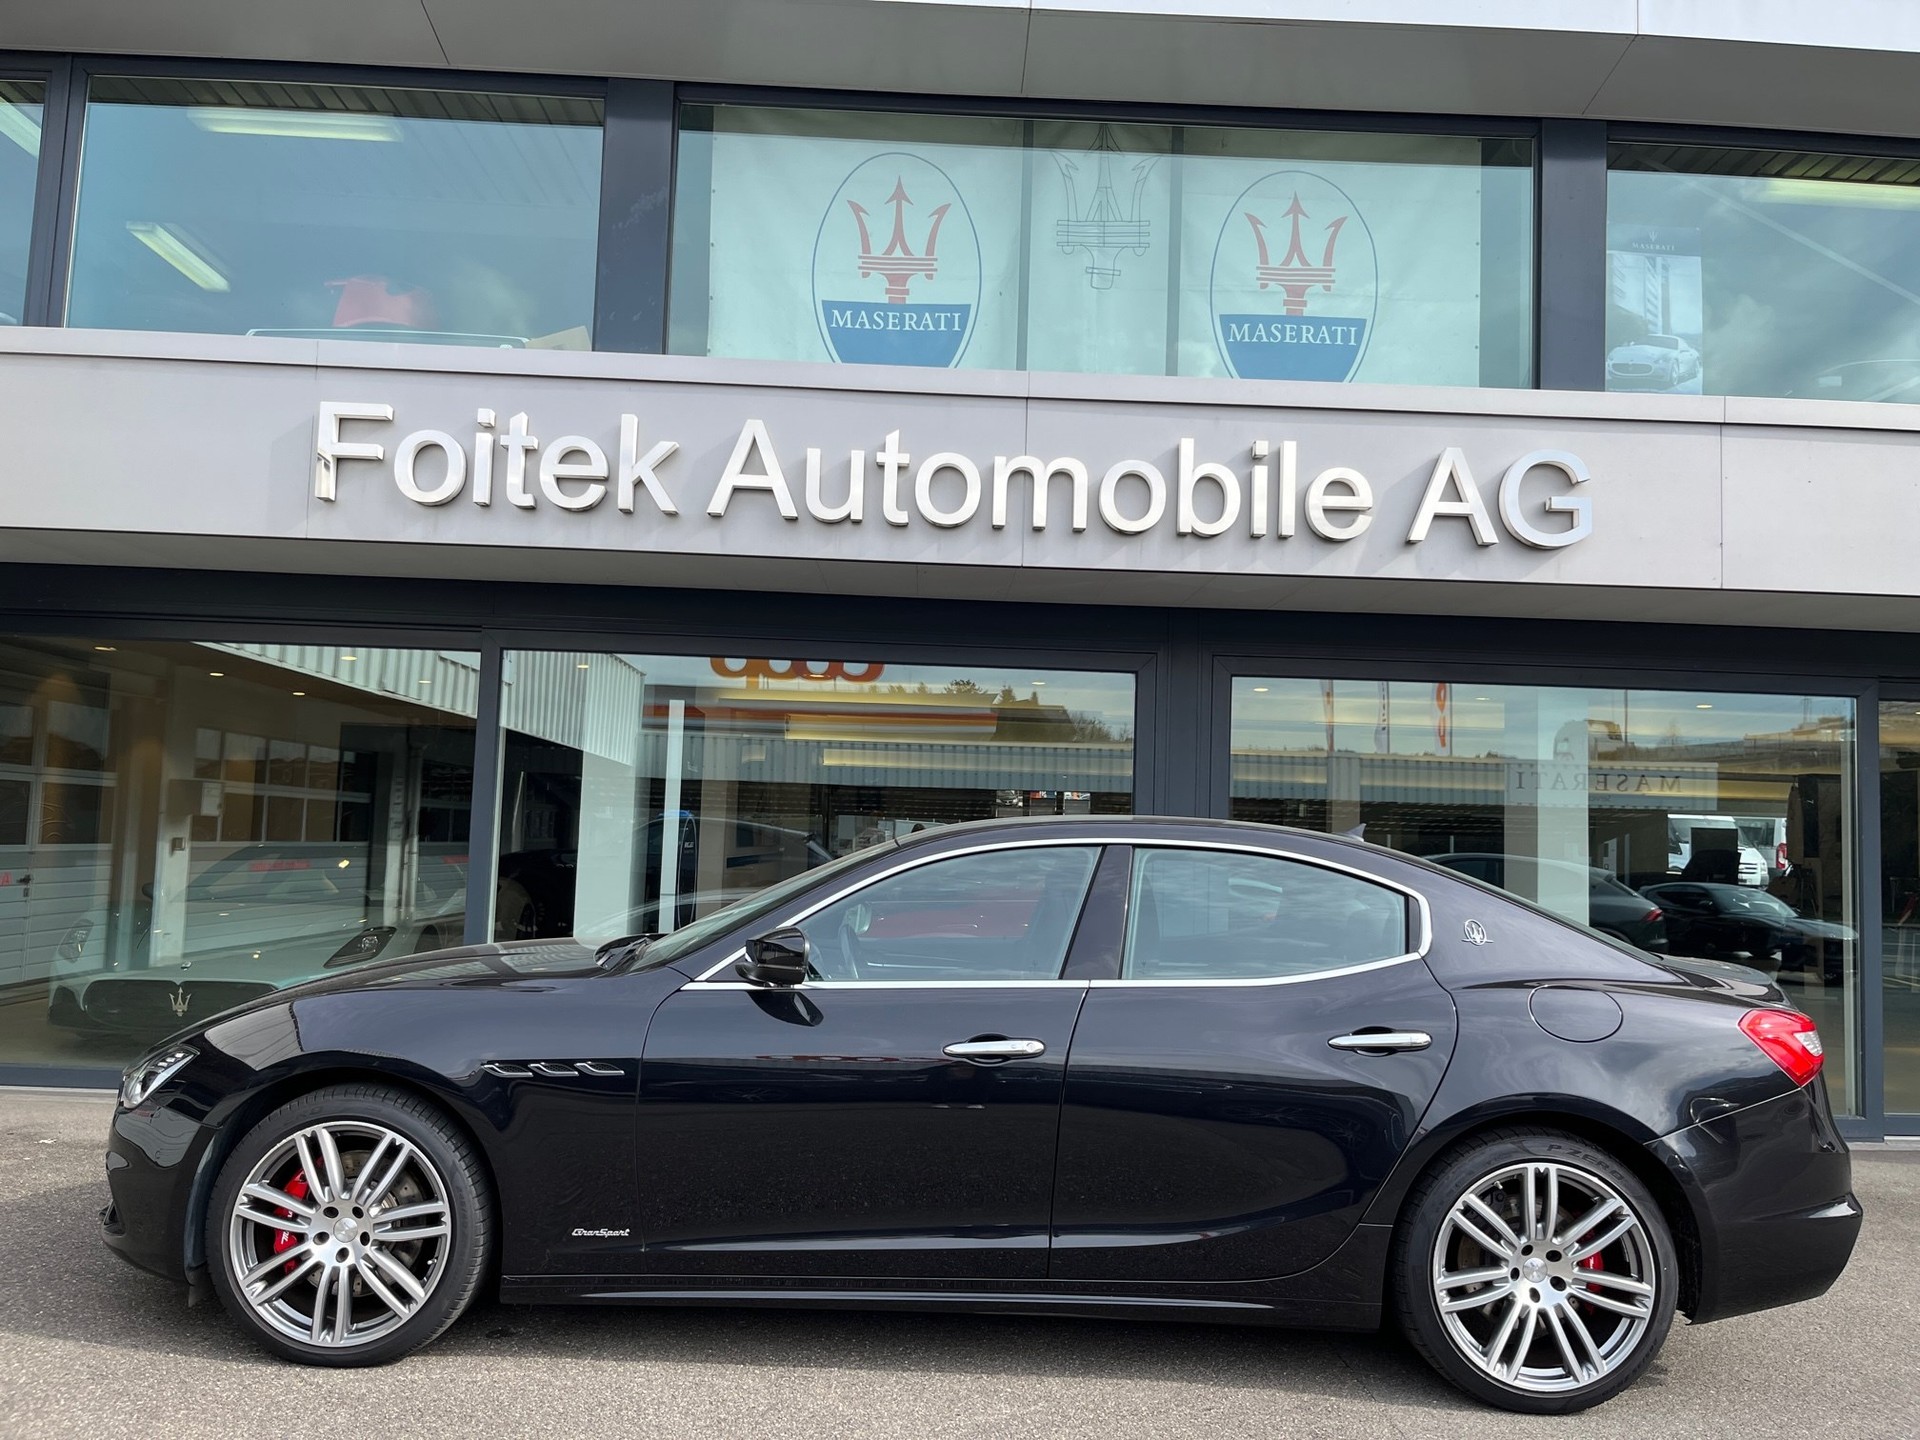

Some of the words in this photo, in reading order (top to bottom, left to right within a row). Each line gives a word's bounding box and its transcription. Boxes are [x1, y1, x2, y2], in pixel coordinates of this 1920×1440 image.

[1632, 242, 1676, 251] MASERATI
[830, 309, 961, 331] MASERATI
[1228, 323, 1357, 346] MASERATI
[315, 401, 680, 516] Foitek
[706, 419, 1374, 542] Automobile
[1405, 447, 1593, 550] AG
